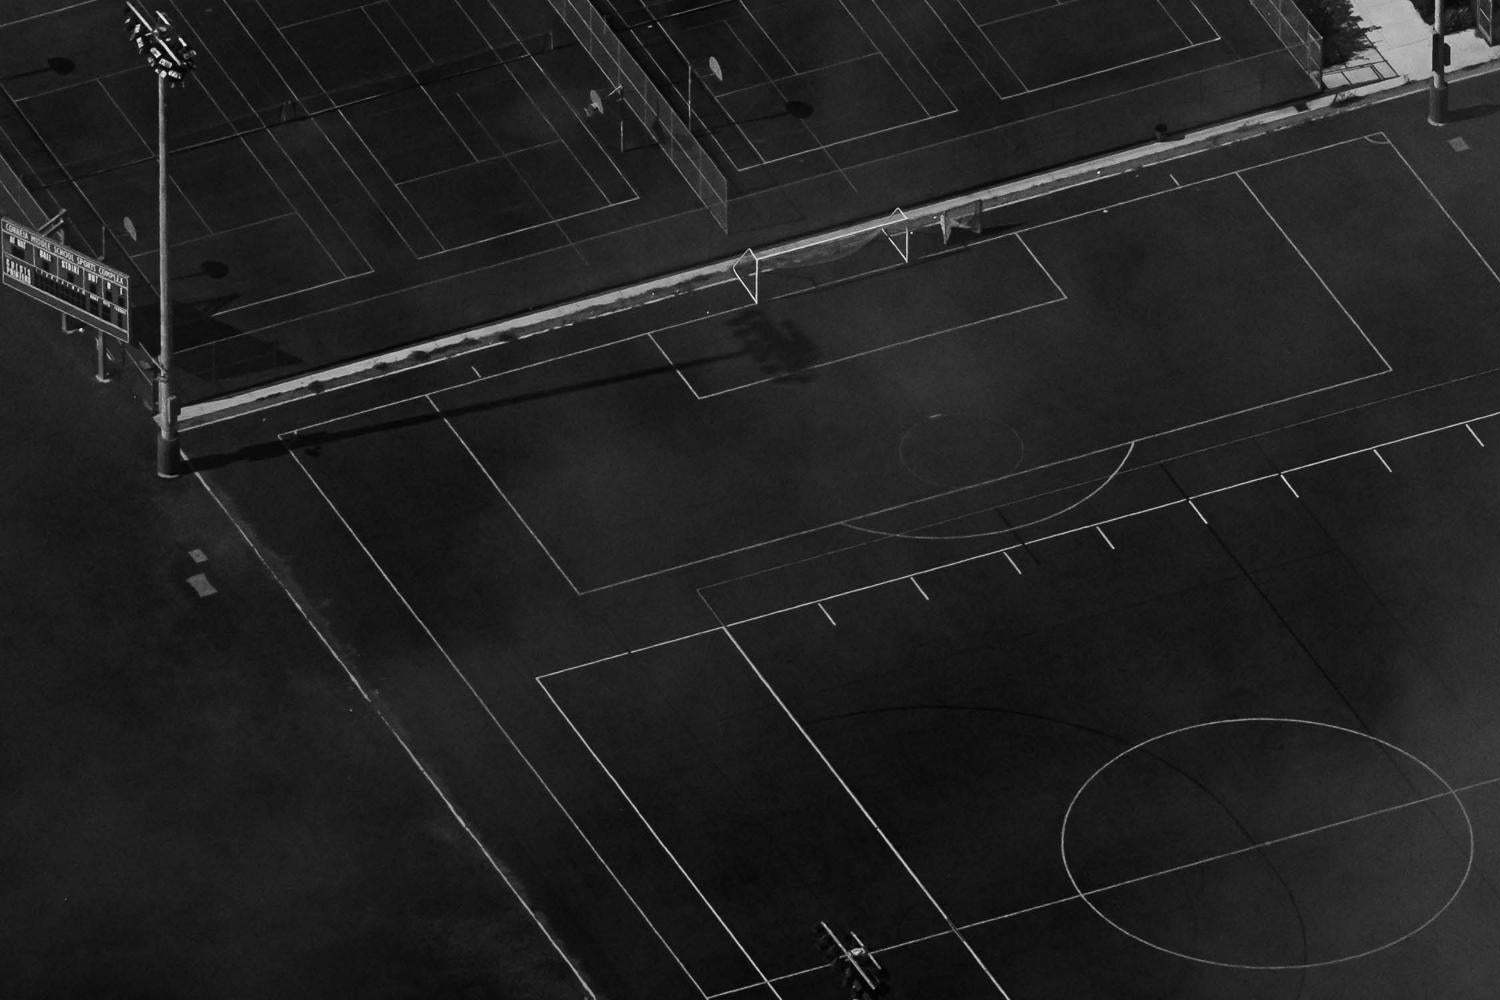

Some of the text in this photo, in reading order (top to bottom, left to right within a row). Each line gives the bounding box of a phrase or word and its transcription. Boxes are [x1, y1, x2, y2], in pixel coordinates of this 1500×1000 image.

[53, 246, 74, 262] SCHOOL
[76, 256, 98, 272] SPORTS
[98, 267, 124, 285] COMPLEX
